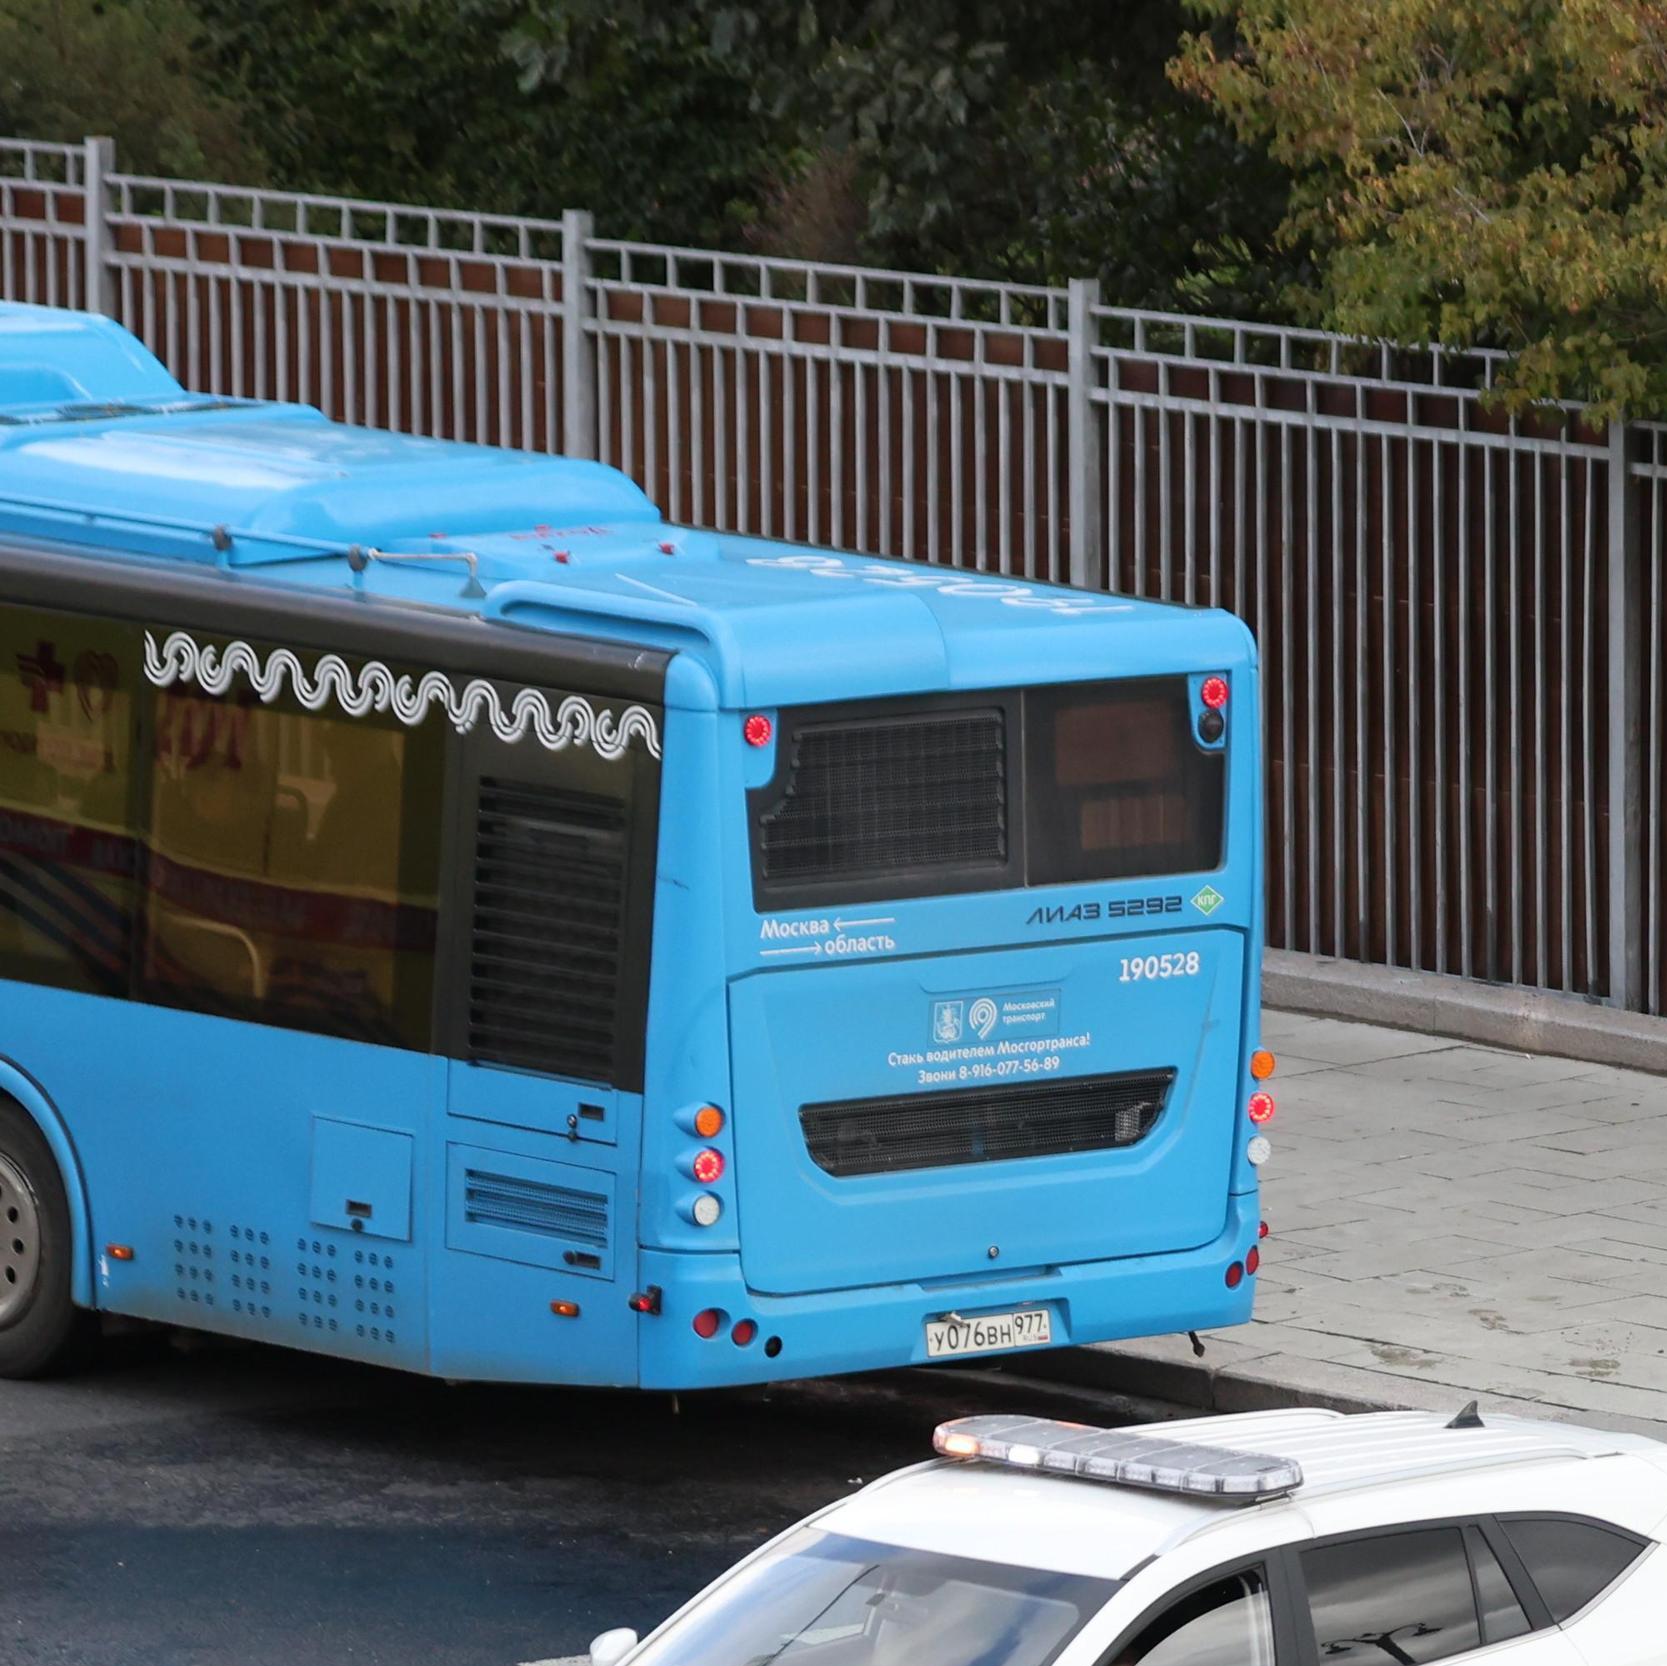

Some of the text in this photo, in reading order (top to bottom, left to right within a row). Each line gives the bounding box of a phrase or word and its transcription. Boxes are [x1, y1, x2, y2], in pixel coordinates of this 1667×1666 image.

[1026, 895, 1183, 925] ЛИАЗ 5292
[1197, 894, 1217, 905] КПГ
[760, 919, 830, 940] Москва
[824, 934, 896, 955] область
[1119, 951, 1200, 982] 190528
[1003, 998, 1056, 1012] Московский
[1003, 1012, 1046, 1025] транспорт
[888, 1032, 1091, 1067] Стань водителем Мосгортранса!
[918, 1056, 1061, 1085] Звони 8-916-077-56-89
[934, 1313, 1043, 1351] У076ВН 977
